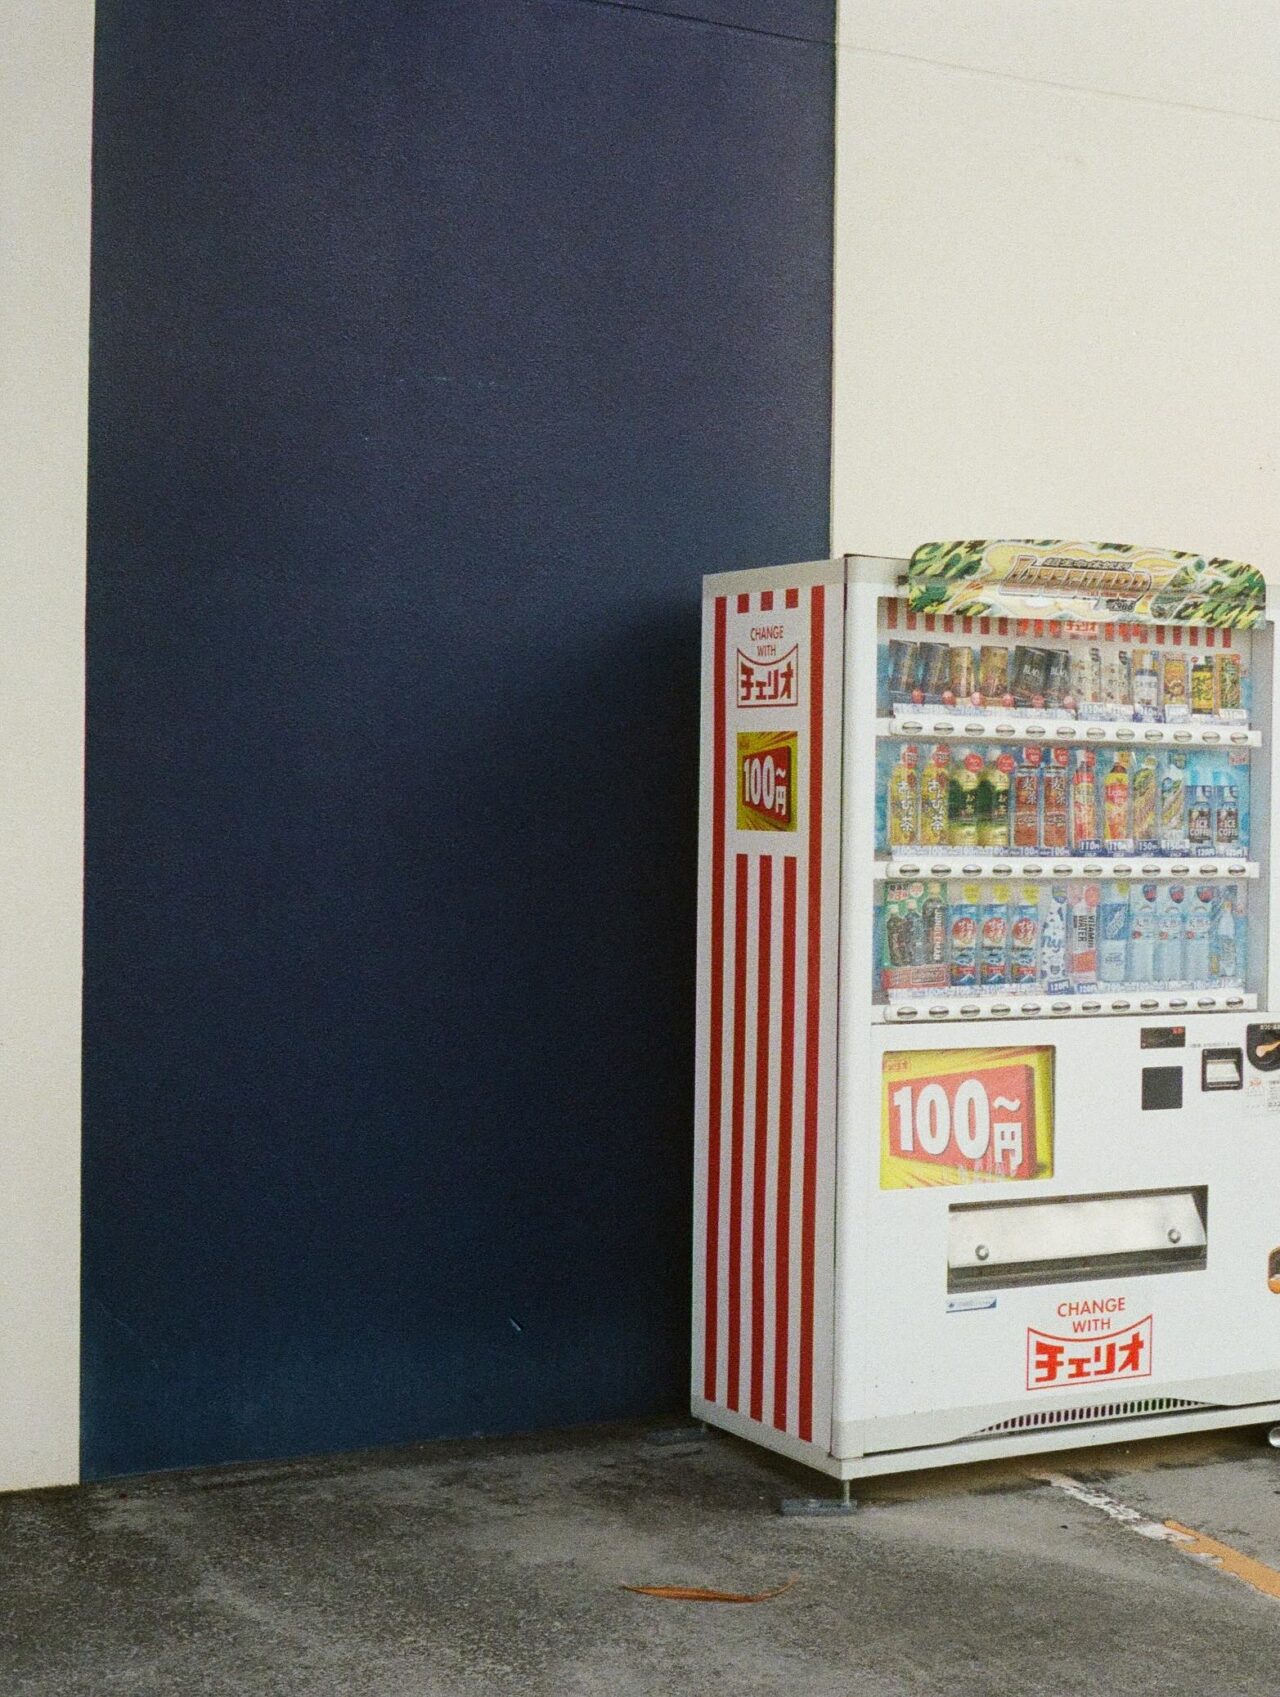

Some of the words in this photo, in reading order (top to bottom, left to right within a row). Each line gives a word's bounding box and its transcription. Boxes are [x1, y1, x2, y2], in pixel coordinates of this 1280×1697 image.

[751, 625, 784, 641] CHANGE
[757, 645, 776, 657] WITH
[741, 661, 794, 701] チェリオ
[1057, 1297, 1126, 1318] CHANGE
[1072, 1318, 1111, 1334] WITH
[1035, 1331, 1144, 1383] チェリオ
